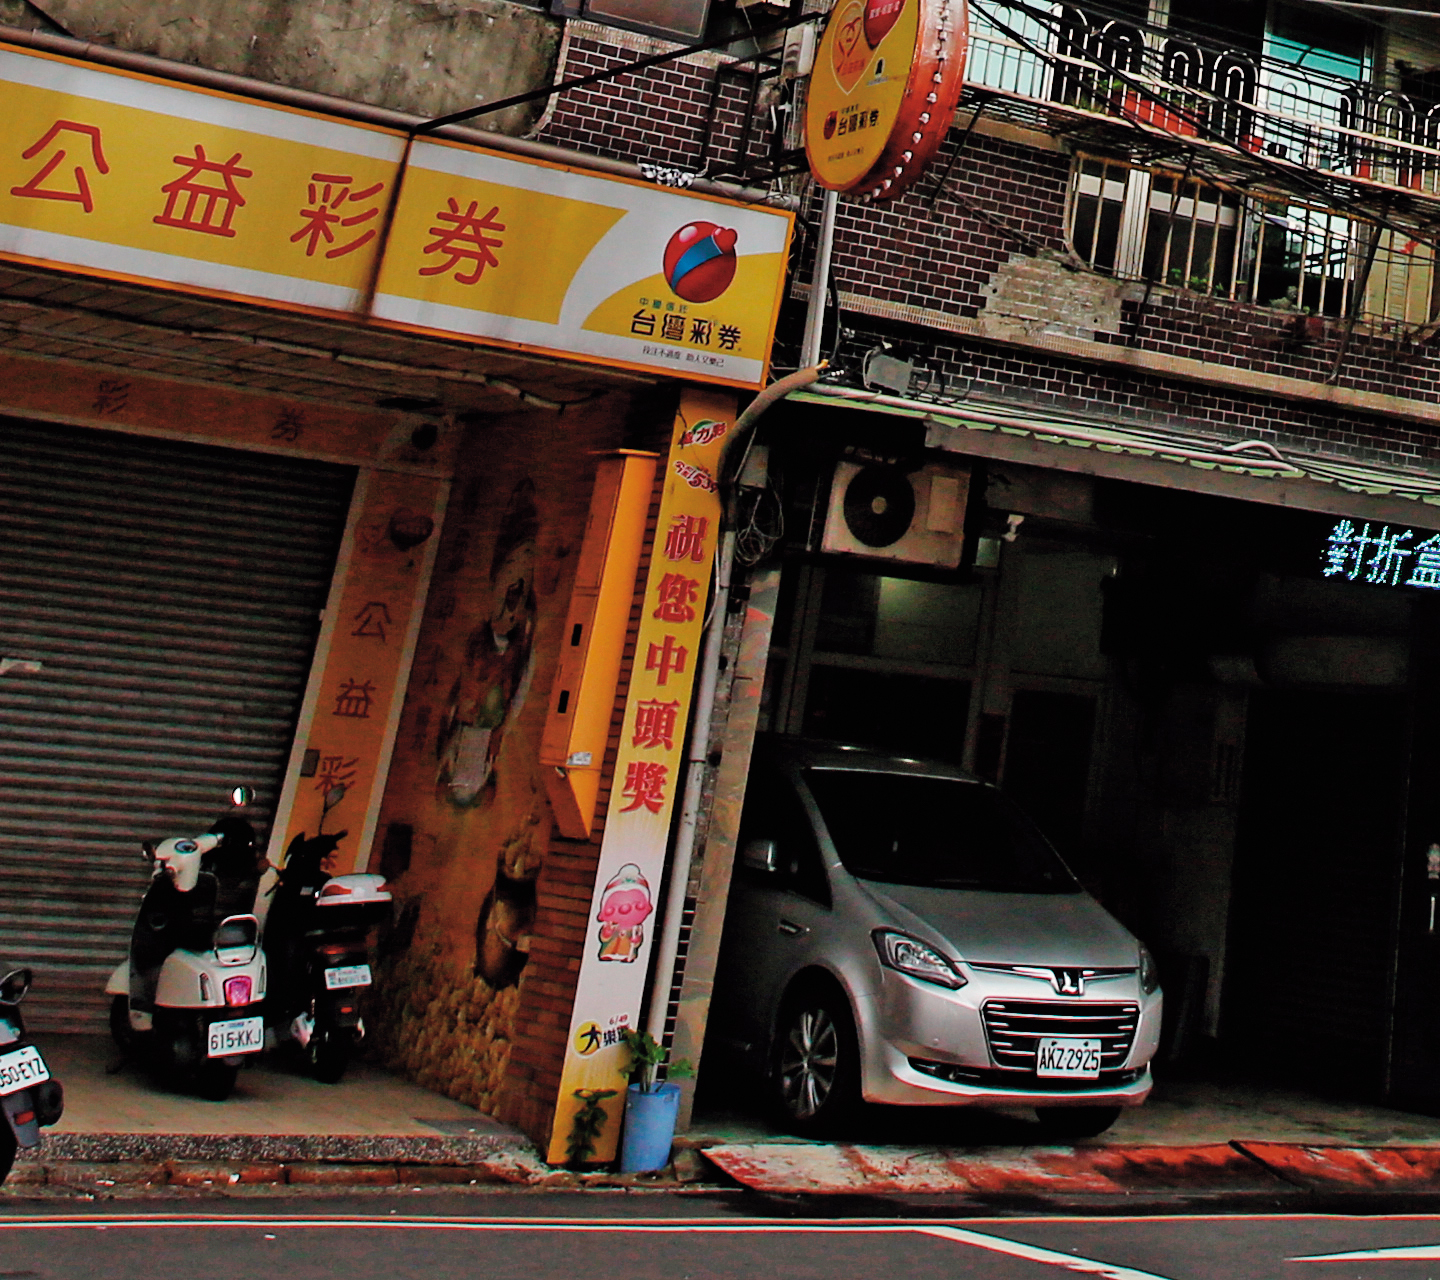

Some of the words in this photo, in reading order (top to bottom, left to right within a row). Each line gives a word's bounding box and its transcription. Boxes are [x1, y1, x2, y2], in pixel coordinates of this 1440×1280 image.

[9, 119, 506, 287] 公益彩券
[631, 308, 741, 350] 台灣彩券
[619, 513, 710, 815] 祝您中頭獎
[211, 1027, 262, 1051] 615-KKJ
[1039, 1047, 1099, 1071] AKZ-2925
